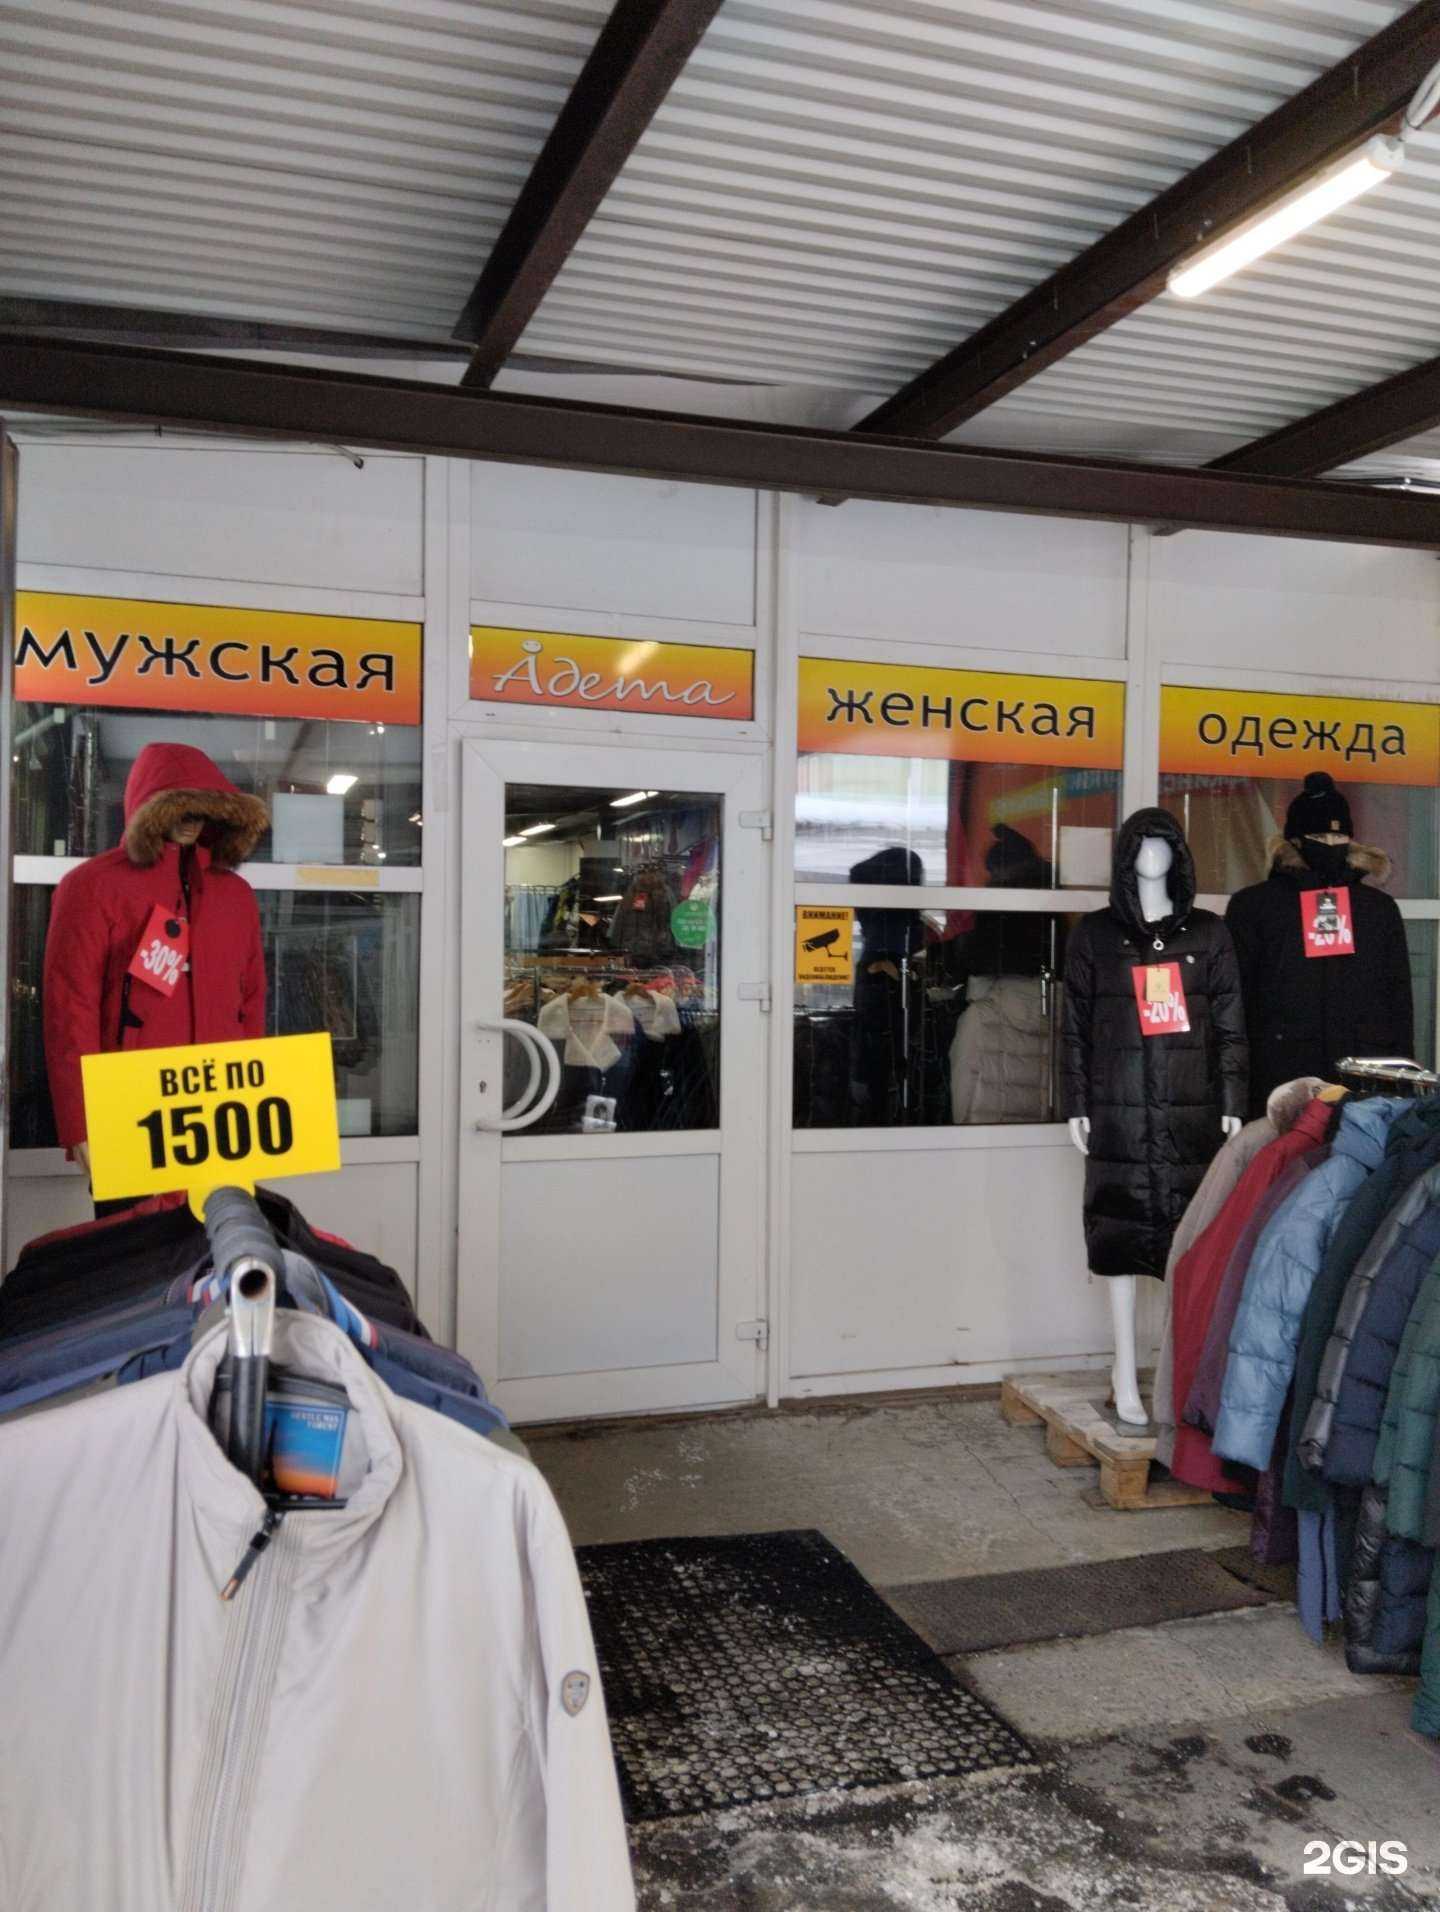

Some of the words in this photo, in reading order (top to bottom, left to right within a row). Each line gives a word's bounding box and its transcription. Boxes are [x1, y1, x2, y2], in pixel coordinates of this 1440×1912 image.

[14, 626, 395, 692] мужская
[826, 687, 1095, 738] женская
[1198, 712, 1407, 763] одежда
[140, 939, 182, 986] -30%
[159, 1059, 217, 1097] ВСЁ
[226, 1060, 265, 1090] ПО
[137, 1096, 293, 1169] 1500
